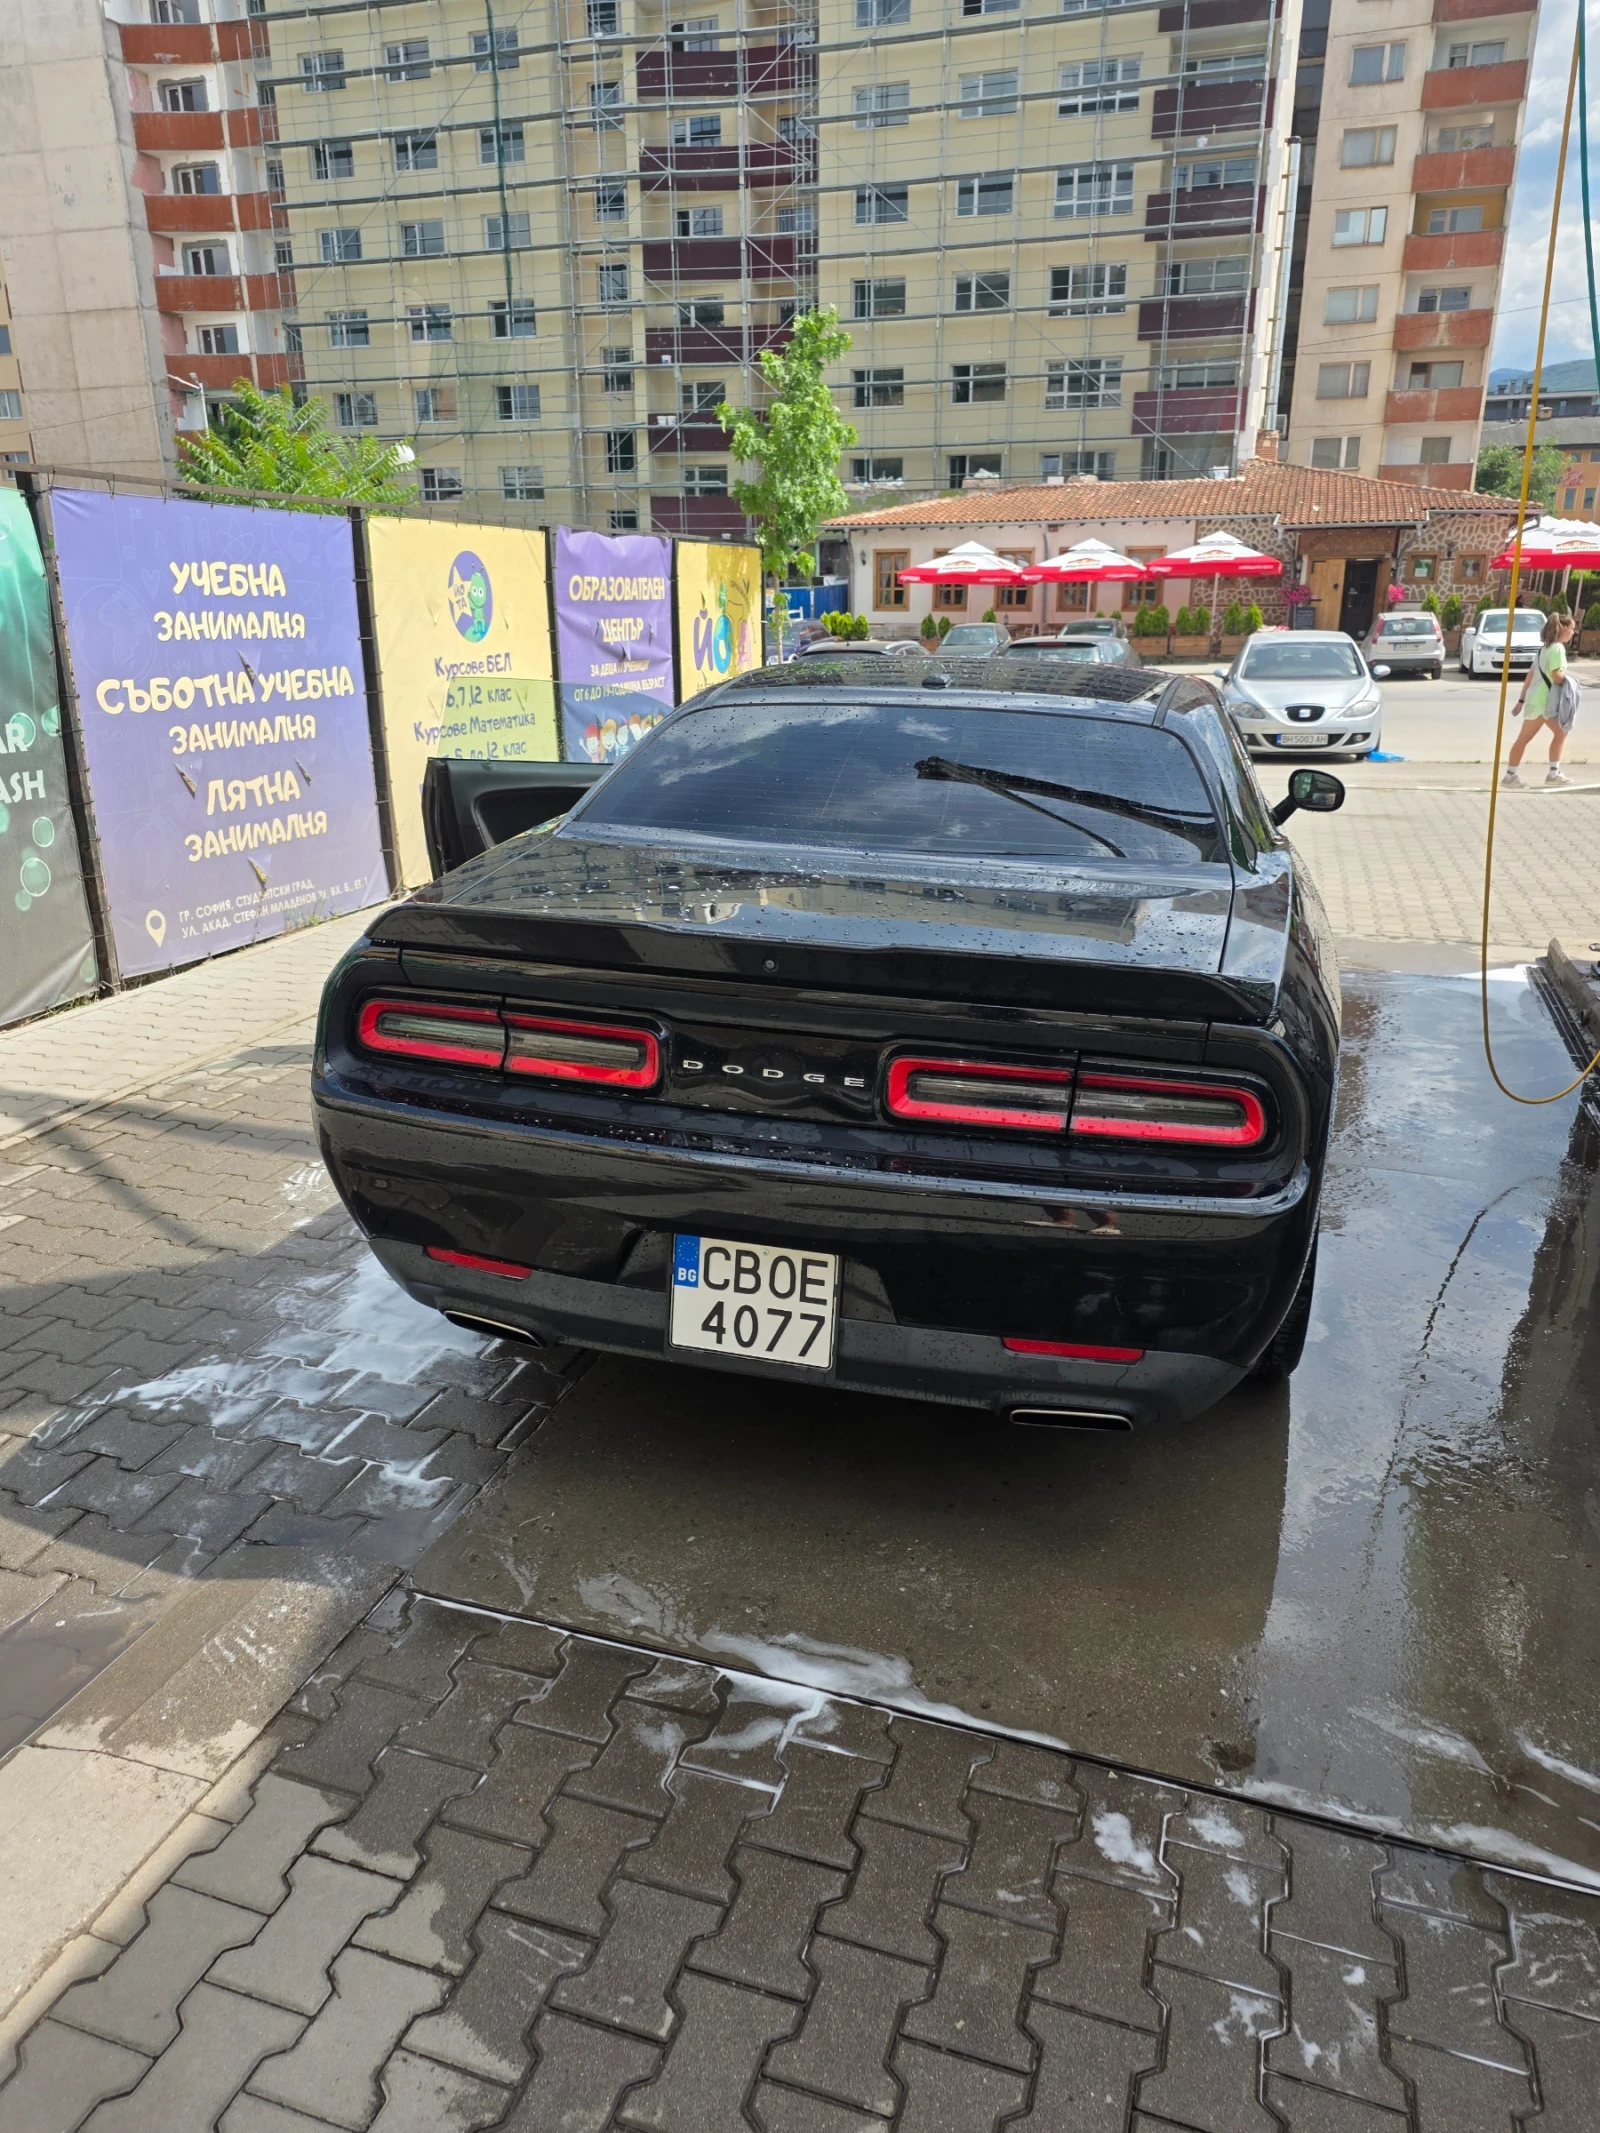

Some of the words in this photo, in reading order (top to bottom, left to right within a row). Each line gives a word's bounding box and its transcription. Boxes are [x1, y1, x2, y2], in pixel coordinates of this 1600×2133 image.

[169, 560, 287, 597] УЧЕБНА
[568, 575, 665, 601] ОБРАЗОВАТЕЛЕН
[153, 610, 305, 642] ЗАНИМАЛНЯ
[600, 617, 644, 645] ЦЕНТЪР
[434, 656, 485, 682] Курсове
[486, 652, 512, 672] БЕЛ
[590, 663, 599, 677] ЗА
[96, 671, 255, 715] СЪБОТНА
[257, 665, 354, 703] УЧЕБНА
[487, 688, 512, 703] клас
[574, 687, 584, 702] ОТ
[584, 688, 589, 700] 6
[590, 686, 601, 701] ДО
[168, 714, 316, 755] ЗАНИМАЛНЯ
[414, 721, 467, 745] Курсове
[469, 712, 536, 734] Математика
[487, 741, 499, 758] 12
[503, 741, 527, 757] клас
[205, 769, 301, 816] ЛЯТНА
[183, 810, 327, 862] ЗАНИМАЛНЯ
[179, 911, 194, 923] ГР.
[196, 899, 234, 919] СОФИЯ,
[181, 925, 199, 939] УЛ.
[202, 915, 232, 934] АКАД.
[270, 891, 317, 914] МЛАДЕНОВ
[330, 885, 343, 897] ВХ.
[683, 1059, 864, 1088] DODGE
[678, 1267, 697, 1283] BG
[701, 1300, 826, 1357] 4077
